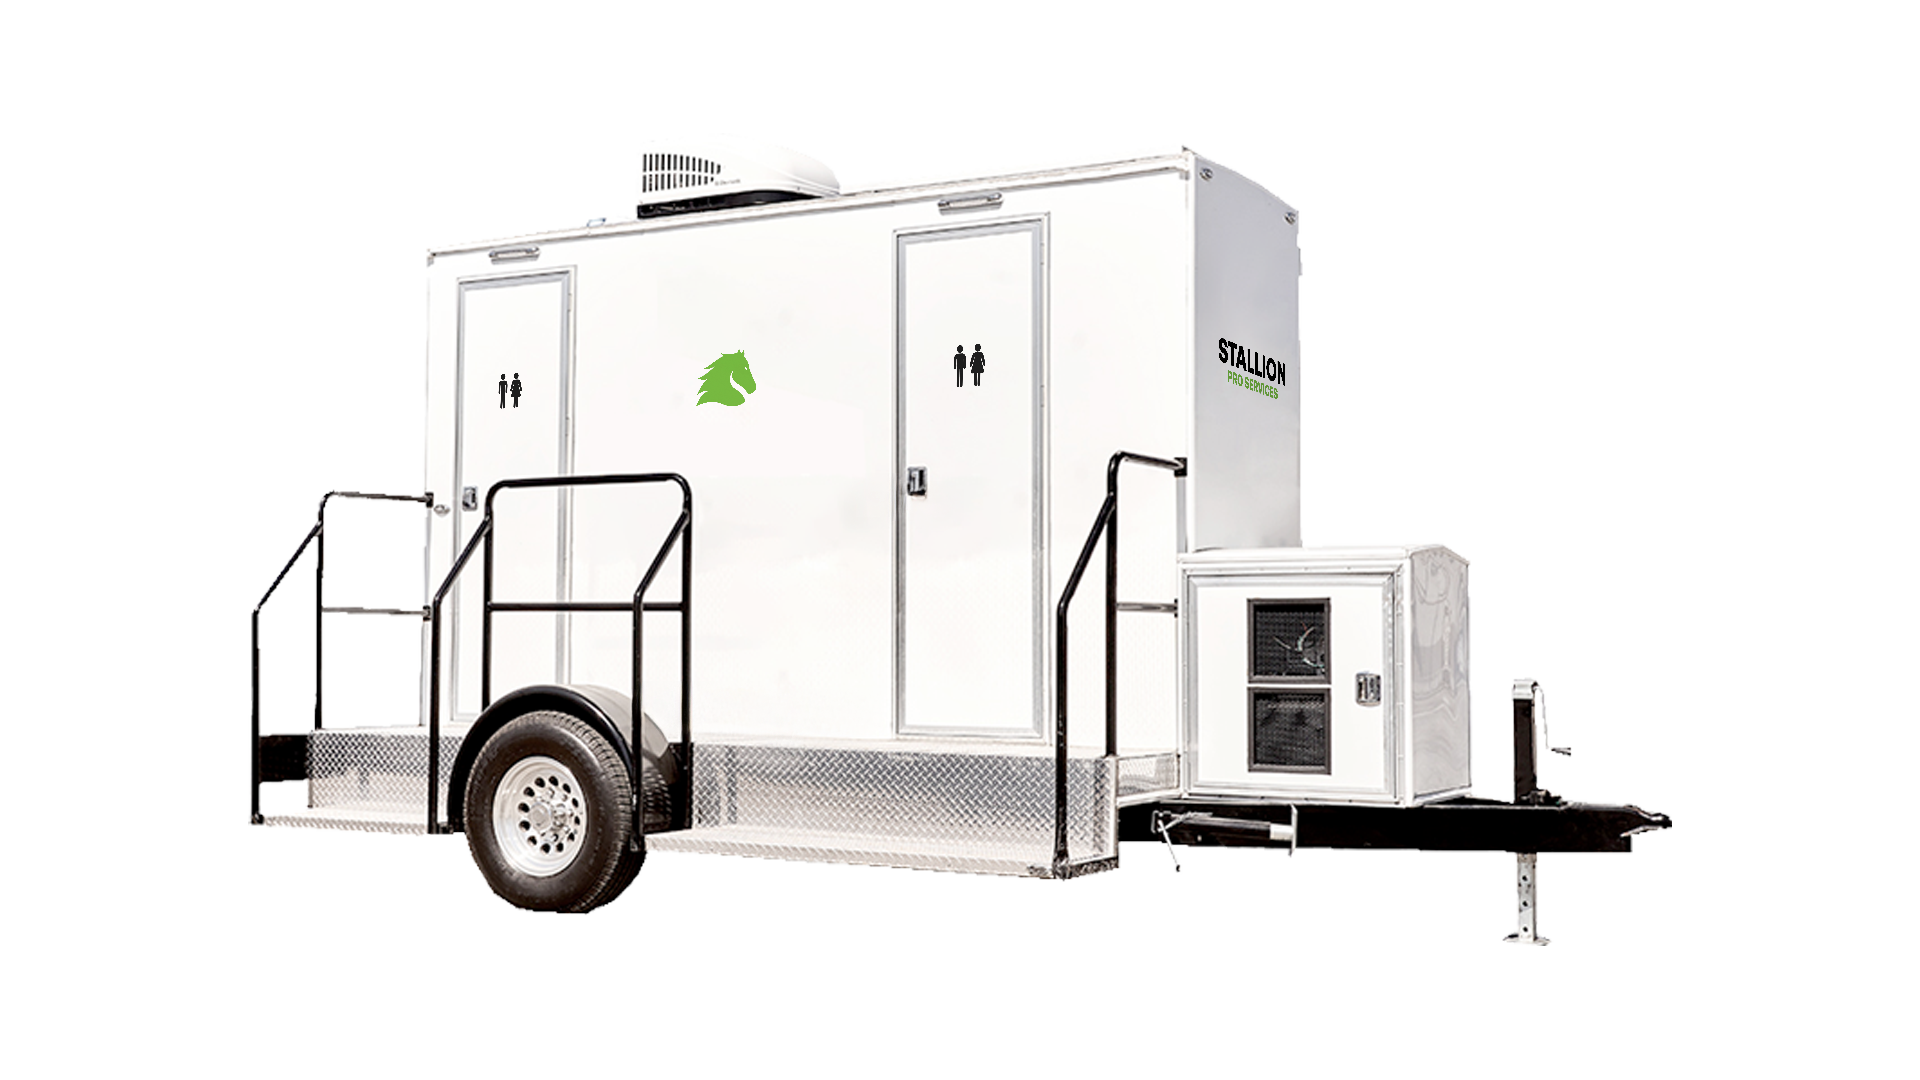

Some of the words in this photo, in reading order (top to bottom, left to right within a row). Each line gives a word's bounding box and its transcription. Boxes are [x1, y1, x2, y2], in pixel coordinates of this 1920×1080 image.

[1218, 337, 1286, 387] STALLION
[1227, 369, 1244, 387] PRO
[1244, 376, 1279, 400] SERVICES
